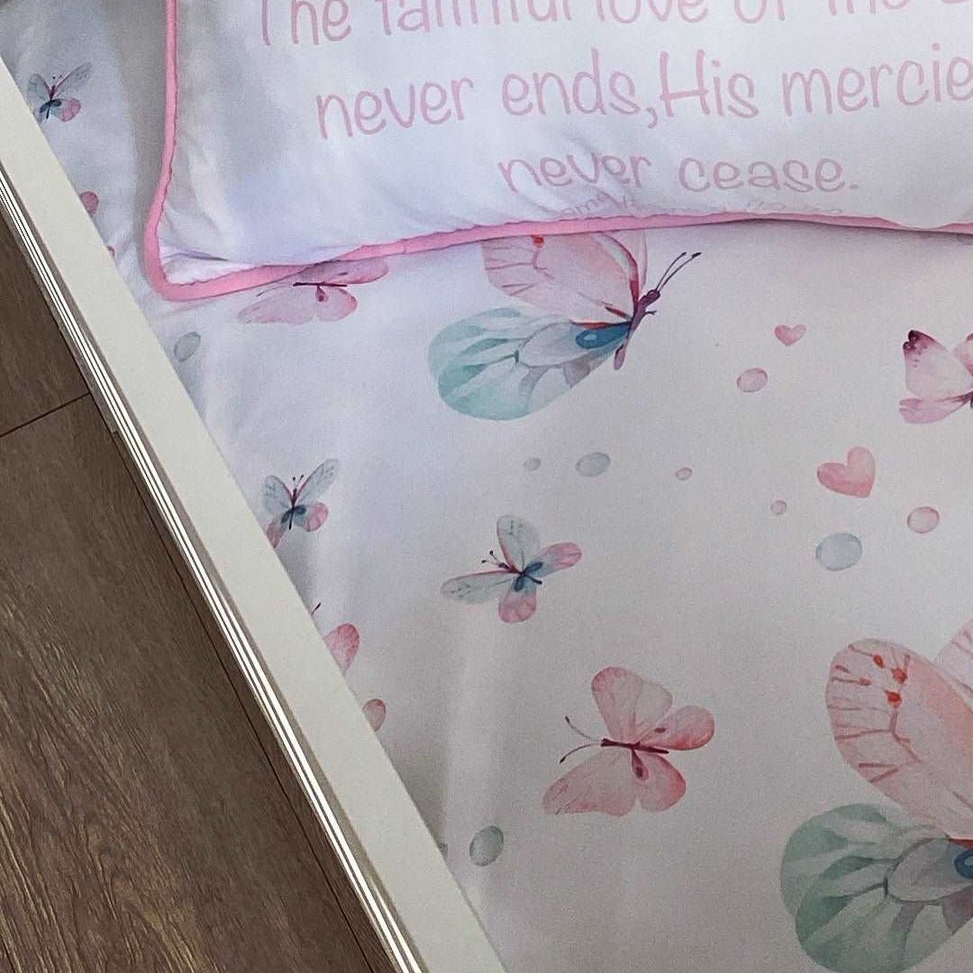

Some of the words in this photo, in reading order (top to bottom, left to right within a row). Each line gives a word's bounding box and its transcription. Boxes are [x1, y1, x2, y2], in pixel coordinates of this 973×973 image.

[316, 77, 474, 139] never
[498, 151, 651, 194] never
[679, 157, 859, 193] cease.
